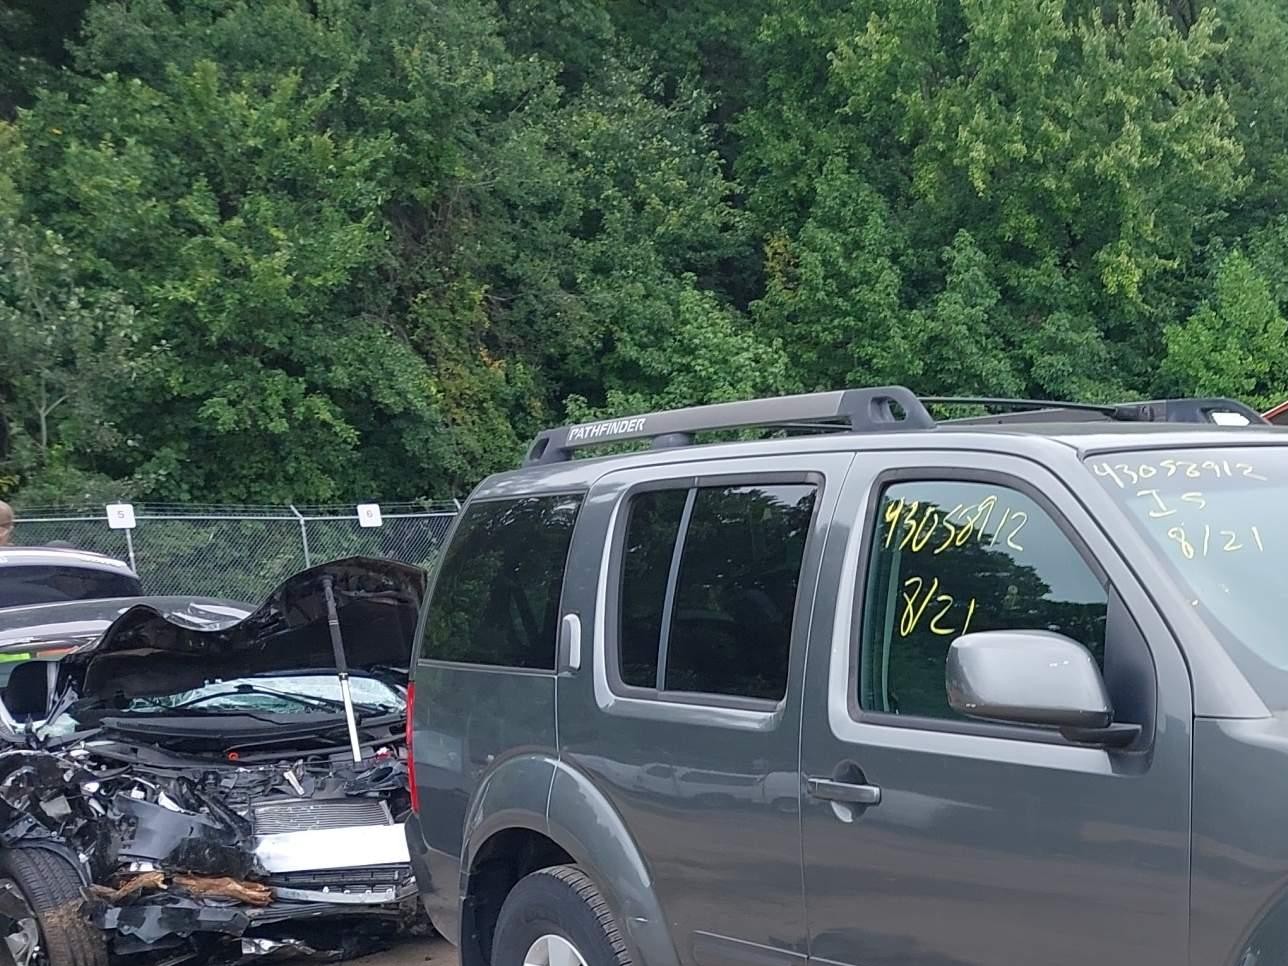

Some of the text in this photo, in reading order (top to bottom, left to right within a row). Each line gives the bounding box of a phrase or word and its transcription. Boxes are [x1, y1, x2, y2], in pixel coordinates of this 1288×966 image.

[568, 418, 646, 441] PATHFINDER
[1093, 459, 1268, 488] 43058912
[884, 495, 1028, 554] 43058912
[1167, 524, 1263, 559] 8/21
[900, 577, 976, 636] 8/21
